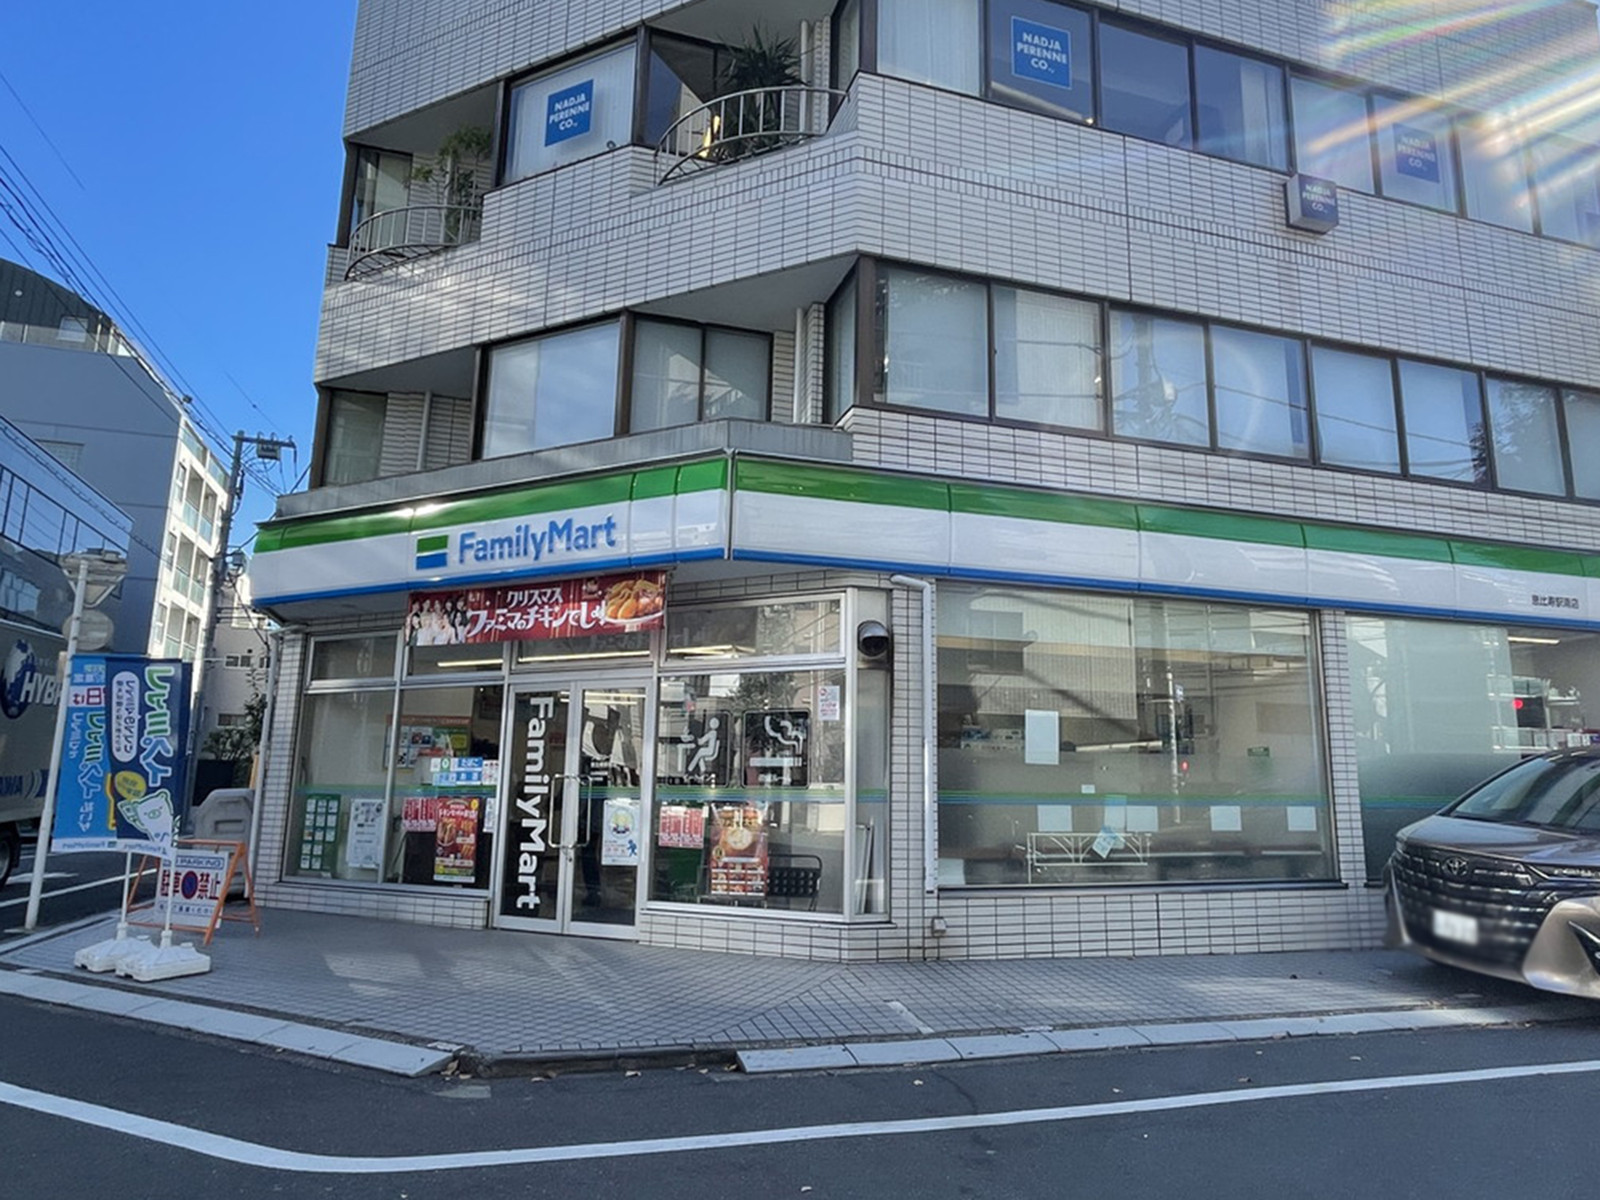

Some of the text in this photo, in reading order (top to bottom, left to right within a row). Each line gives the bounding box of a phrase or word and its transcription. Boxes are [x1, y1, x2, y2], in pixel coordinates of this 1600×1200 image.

[1016, 41, 1068, 65] PERENNE
[1022, 32, 1062, 51] NADJA
[548, 101, 590, 125] PERENNE
[554, 93, 586, 112] NADJA
[458, 512, 617, 564] FamilyMart
[505, 586, 564, 608] クリスマス
[515, 695, 555, 910] FamilyMart
[180, 858, 222, 868] PARKING
